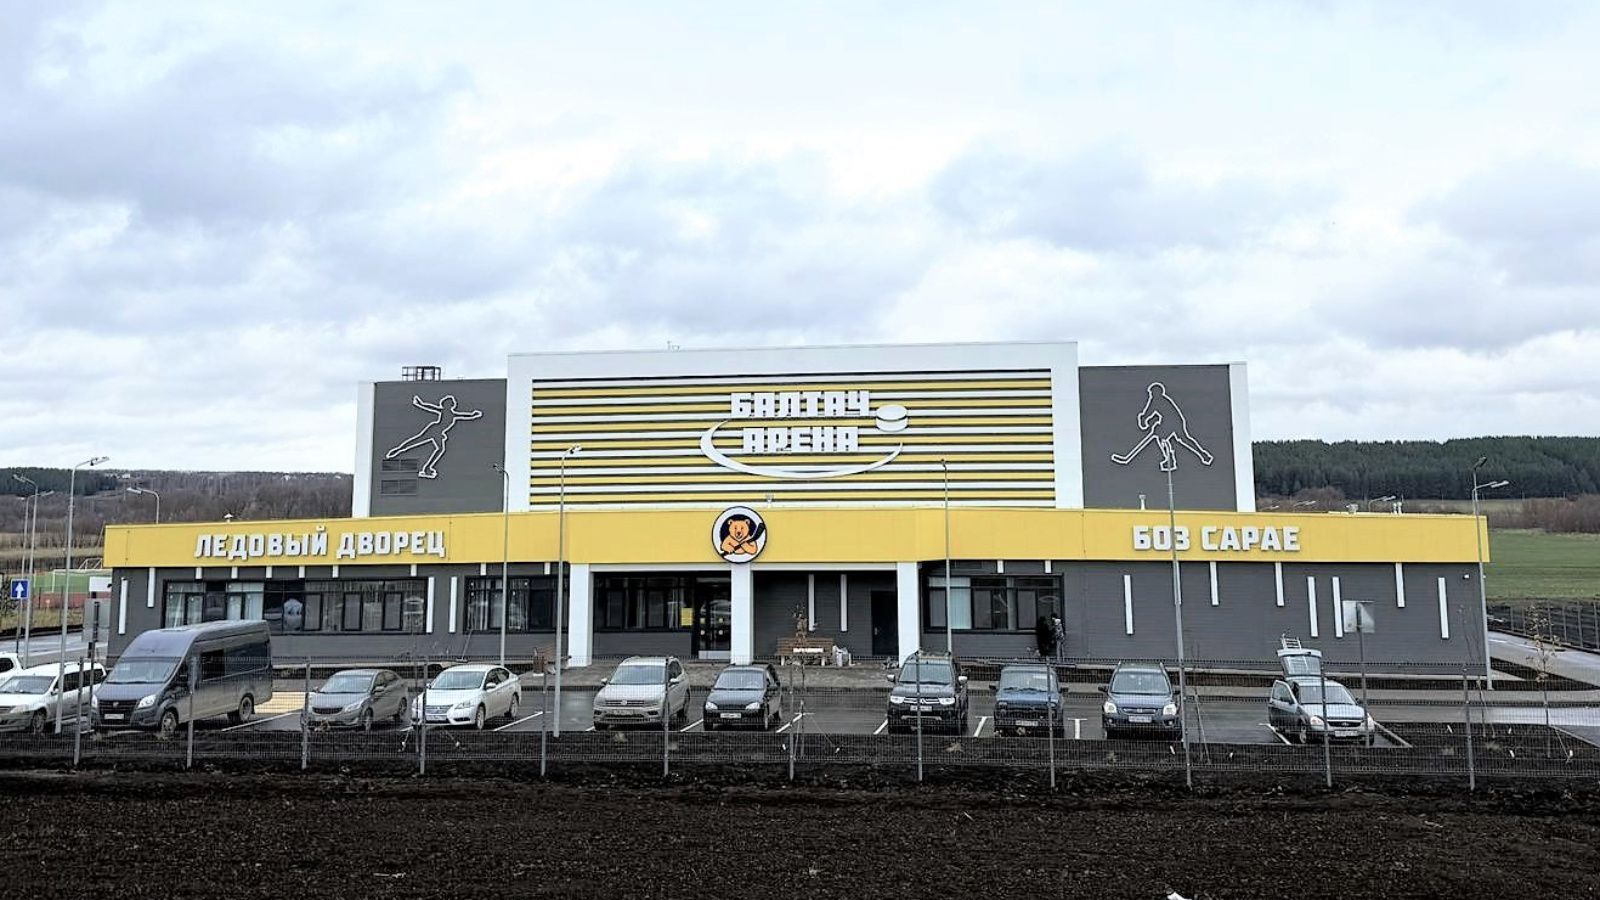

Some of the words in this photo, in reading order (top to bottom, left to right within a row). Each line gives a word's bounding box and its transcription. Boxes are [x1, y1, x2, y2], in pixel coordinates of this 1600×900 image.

[731, 390, 870, 418] БАЛТАЧ
[743, 427, 859, 452] АРЕНА
[194, 525, 329, 561] ЛЕДОВЫЙ
[336, 530, 447, 560] ДВОРЕЦ
[1133, 525, 1191, 551] БОЗ
[1201, 525, 1302, 552] САРАЕ
